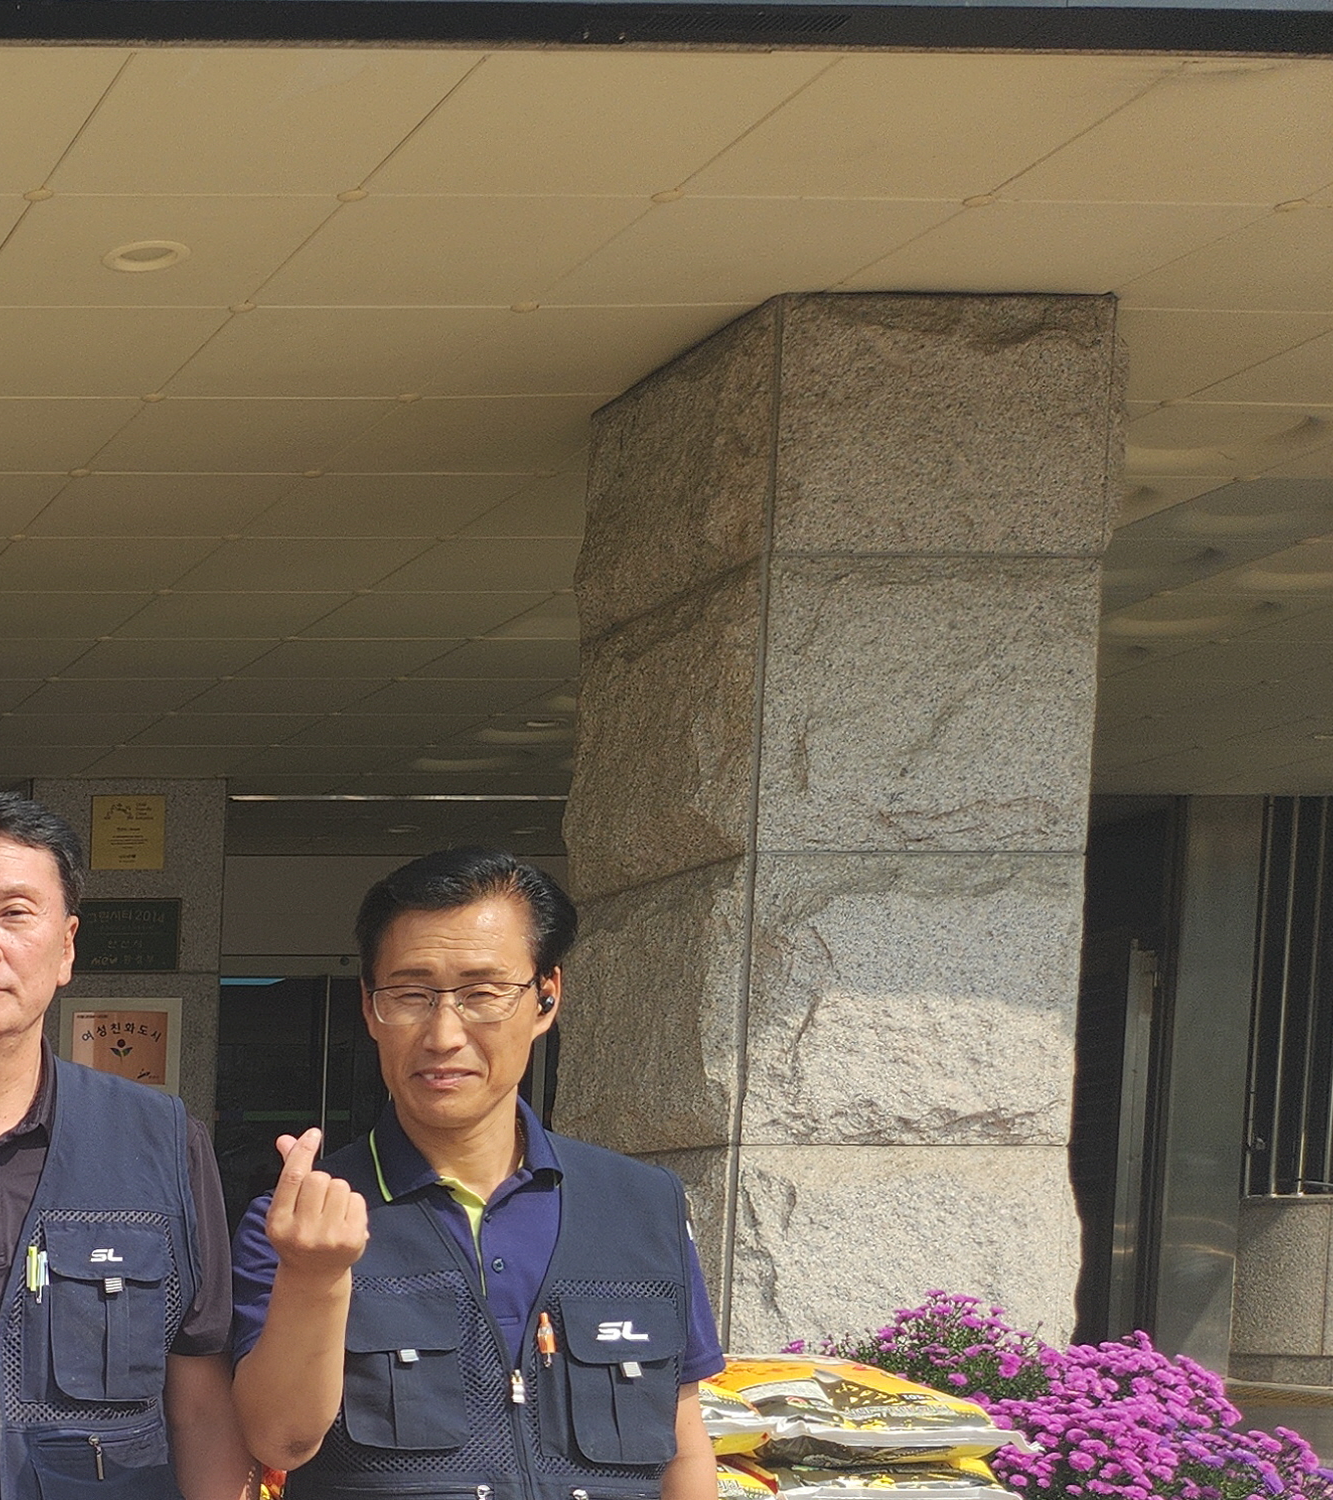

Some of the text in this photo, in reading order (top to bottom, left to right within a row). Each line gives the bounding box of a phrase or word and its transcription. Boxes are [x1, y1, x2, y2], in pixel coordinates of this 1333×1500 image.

[81, 1022, 162, 1043] 여성친화도시
[90, 1249, 123, 1262] SL
[596, 1321, 650, 1341] SL
